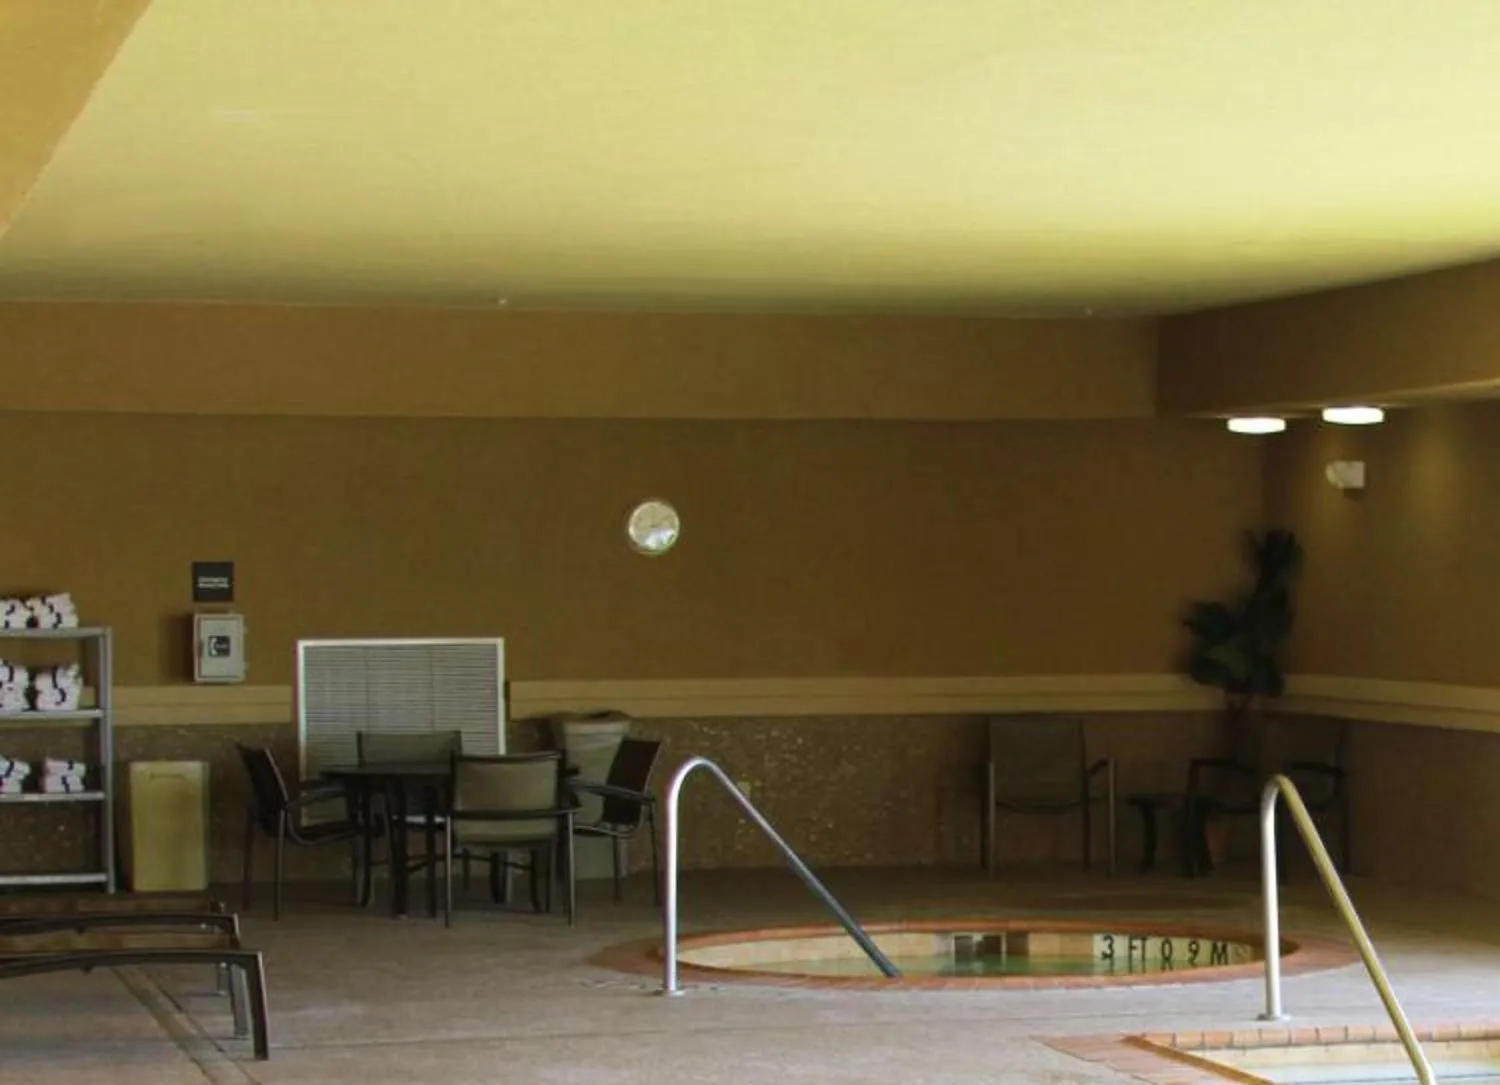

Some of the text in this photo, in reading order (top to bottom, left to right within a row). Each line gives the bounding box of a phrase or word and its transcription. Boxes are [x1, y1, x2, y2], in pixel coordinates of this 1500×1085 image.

[1102, 934, 1116, 962] 3
[1127, 935, 1149, 967] FT
[1188, 939, 1201, 967] 9
[1210, 941, 1228, 965] M
